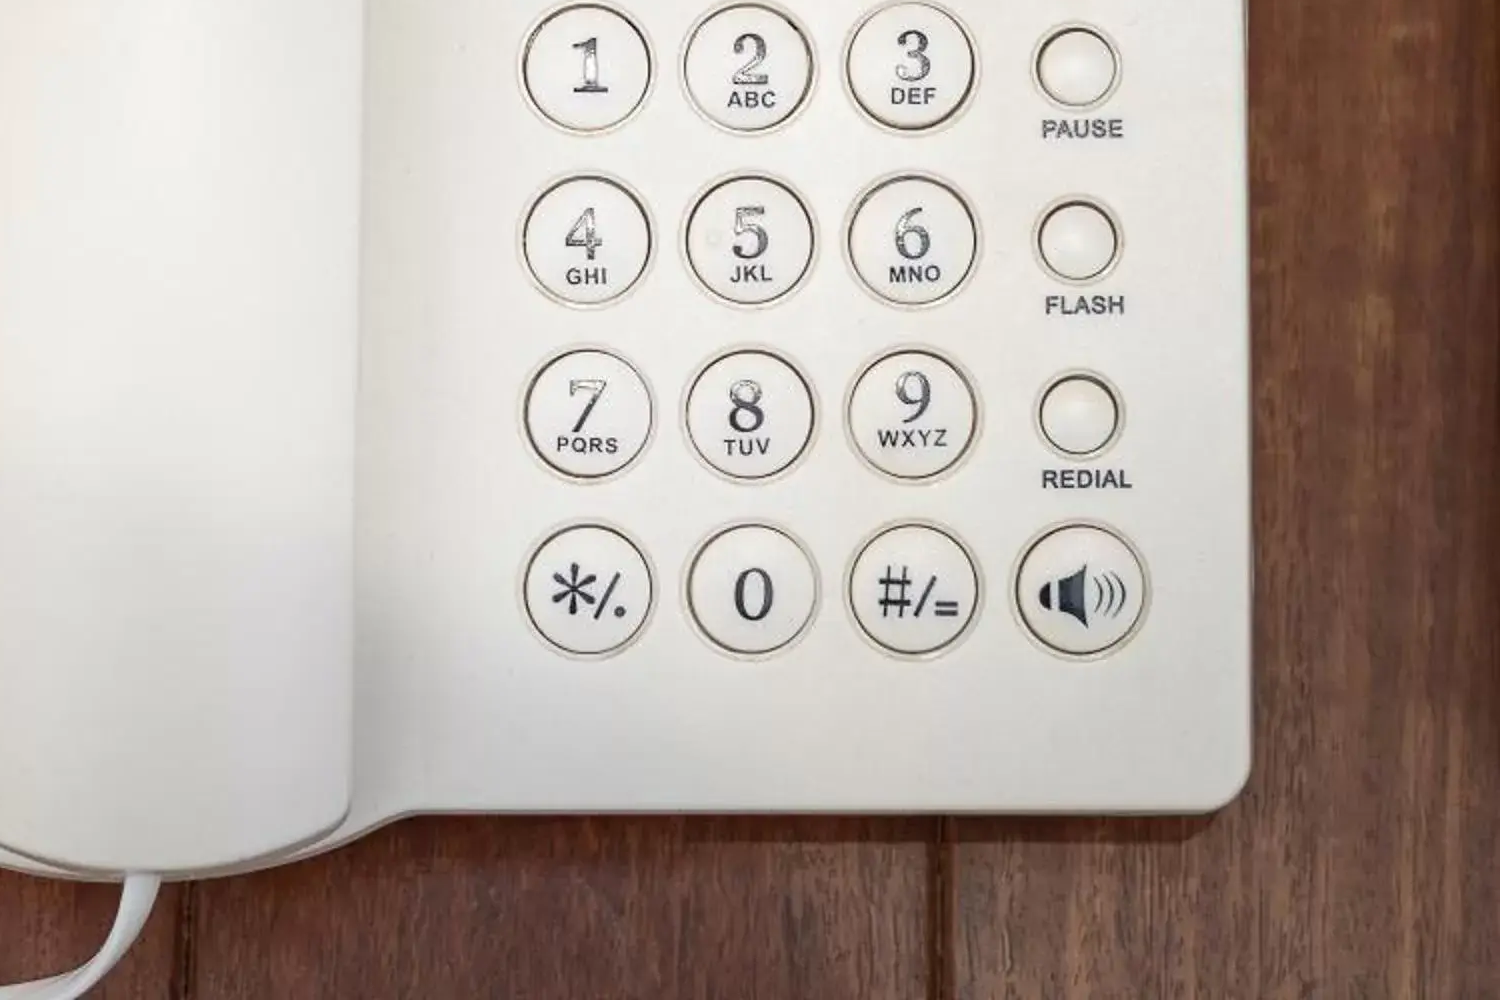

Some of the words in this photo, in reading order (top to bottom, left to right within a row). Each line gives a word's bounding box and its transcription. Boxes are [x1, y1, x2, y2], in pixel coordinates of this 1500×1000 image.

[571, 37, 609, 94] 1
[731, 32, 769, 86] 2
[895, 29, 931, 83] 3
[727, 90, 776, 109] ABC
[890, 87, 937, 105] DEF
[1041, 118, 1124, 139] PAUSE
[564, 207, 603, 261] 4
[731, 206, 769, 260] 5
[894, 206, 931, 261] 6
[565, 267, 607, 286] GHI
[729, 264, 773, 284] JKL
[889, 264, 941, 283] MNO
[1045, 295, 1125, 316] FLASH
[569, 379, 608, 434] 7
[728, 379, 765, 434] 8
[895, 371, 931, 425] 9
[556, 435, 619, 455] PQRS
[723, 437, 771, 457] TUV
[877, 428, 948, 448] WXYZ
[1041, 469, 1133, 489] REDIAL
[733, 567, 774, 622] 0
